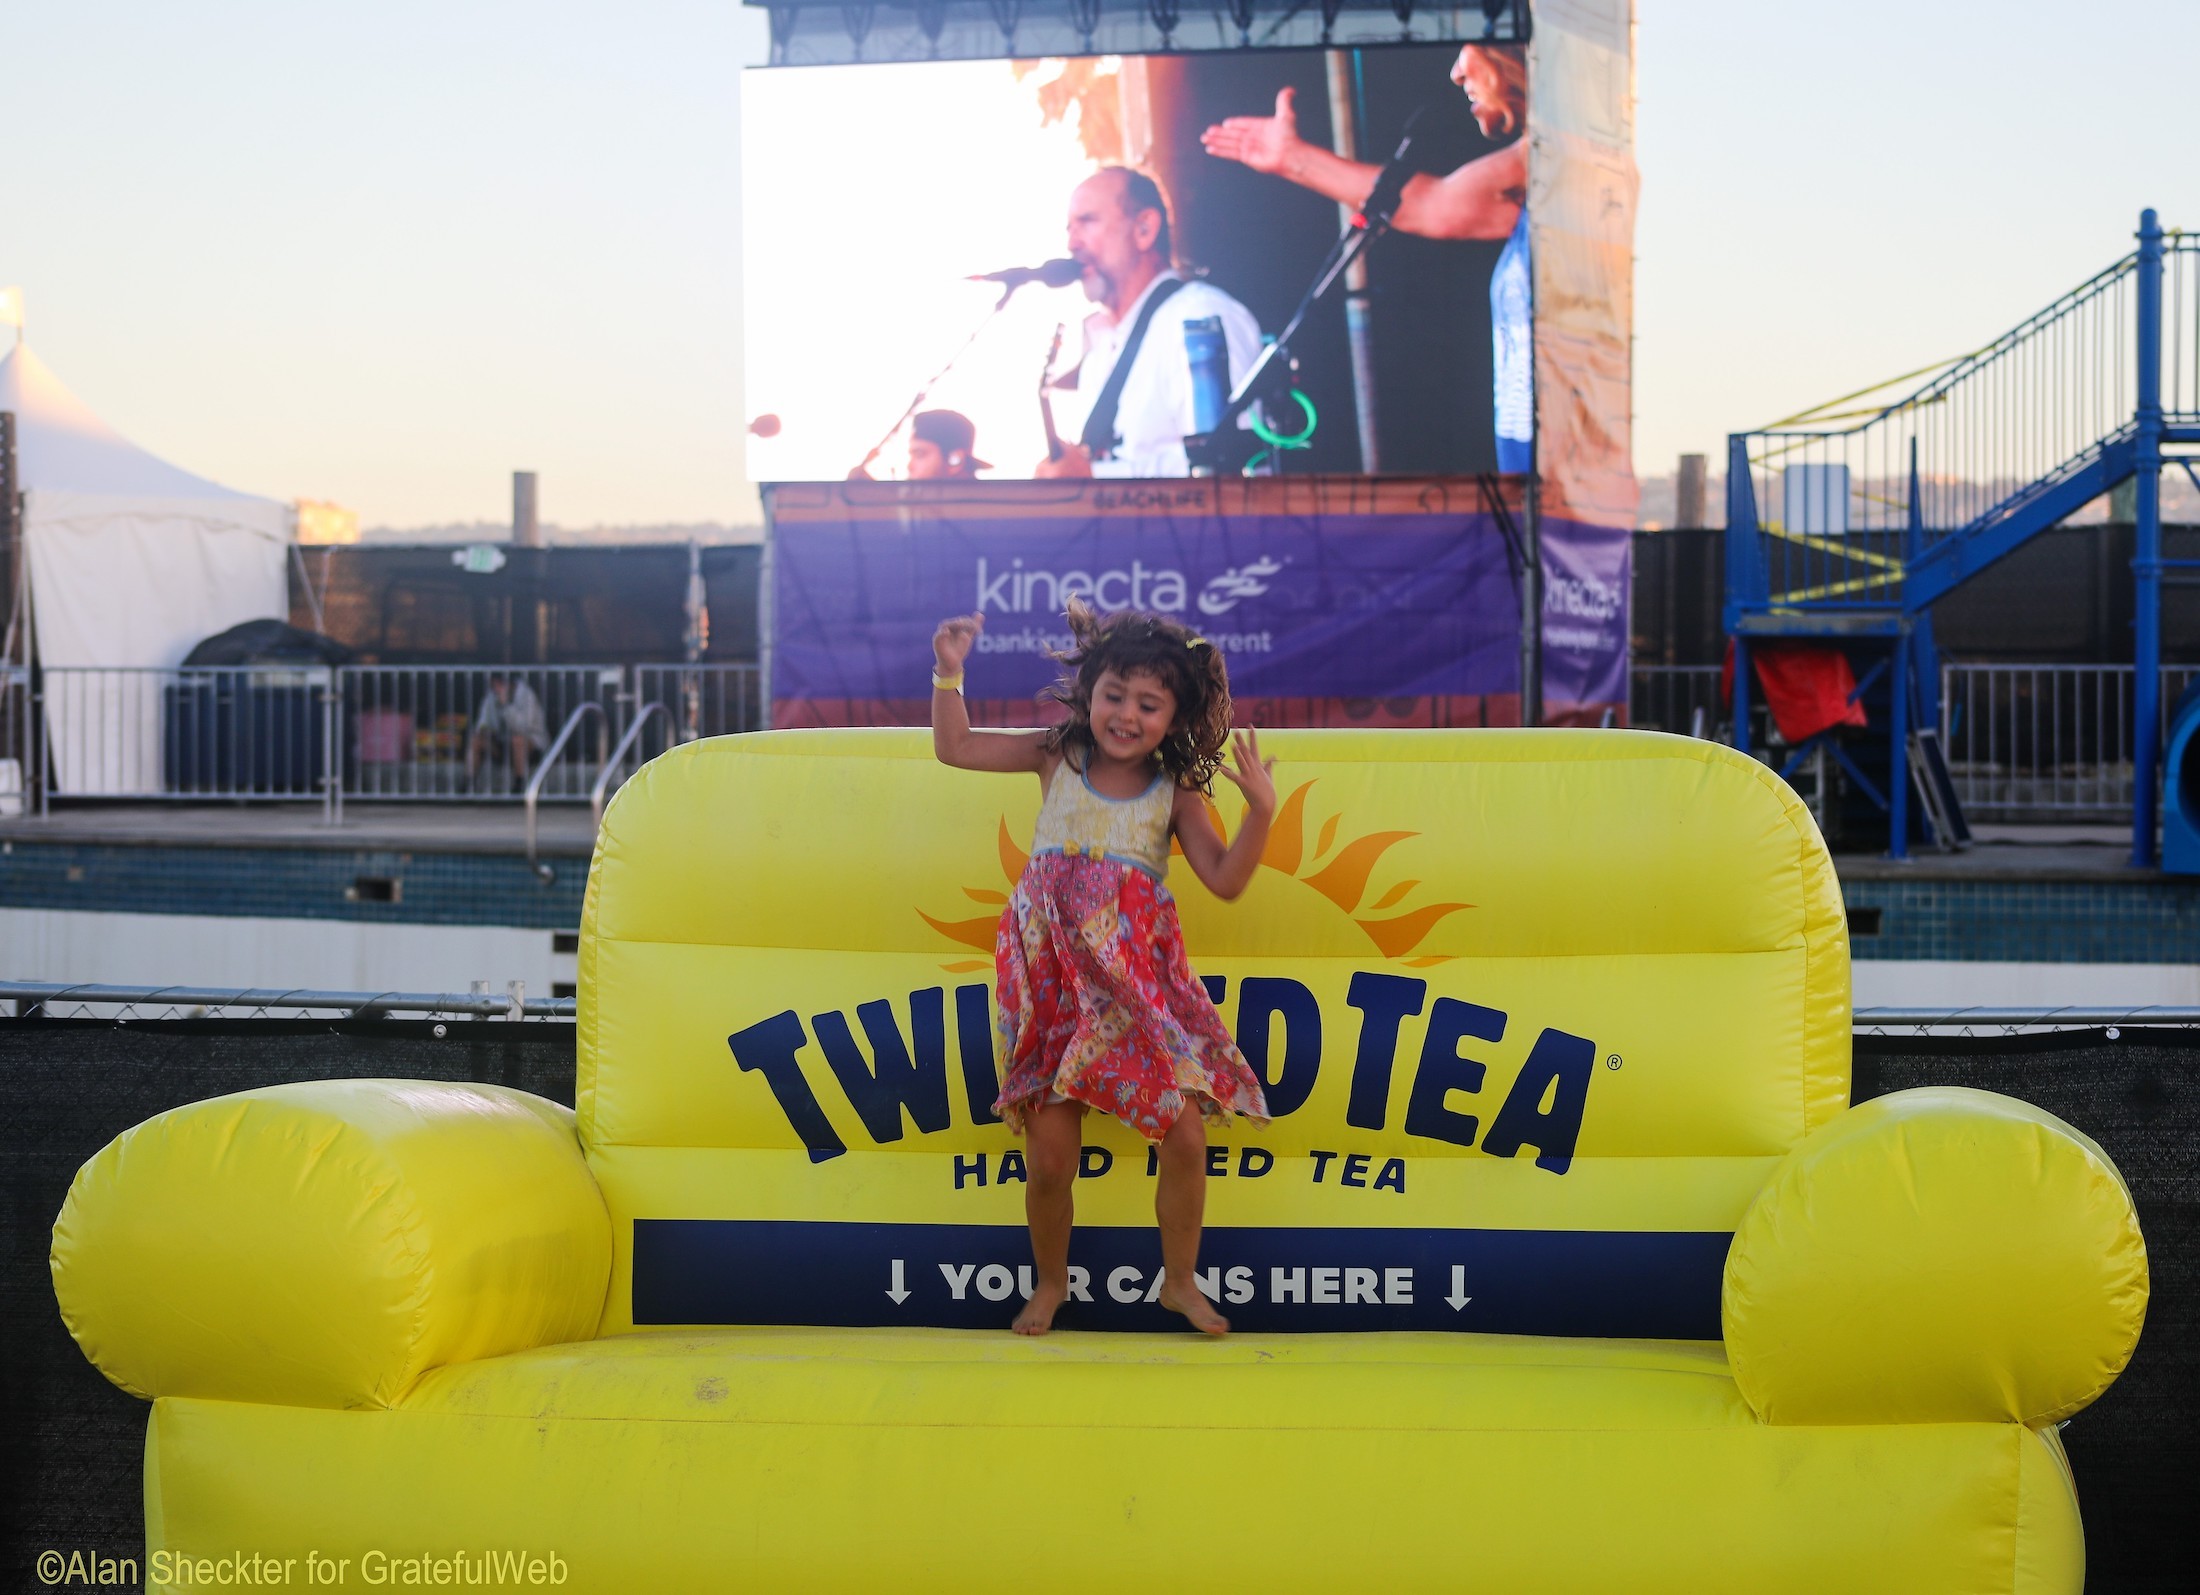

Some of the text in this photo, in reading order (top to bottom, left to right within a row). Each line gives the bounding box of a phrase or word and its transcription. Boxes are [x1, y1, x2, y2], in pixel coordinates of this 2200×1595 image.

[976, 557, 1187, 612] kinecta
[727, 976, 1322, 1165] TWID
[1346, 971, 1597, 1176] TEA
[953, 1145, 1406, 1194] HAD IED TEA
[1270, 1267, 1414, 1305] HERE
